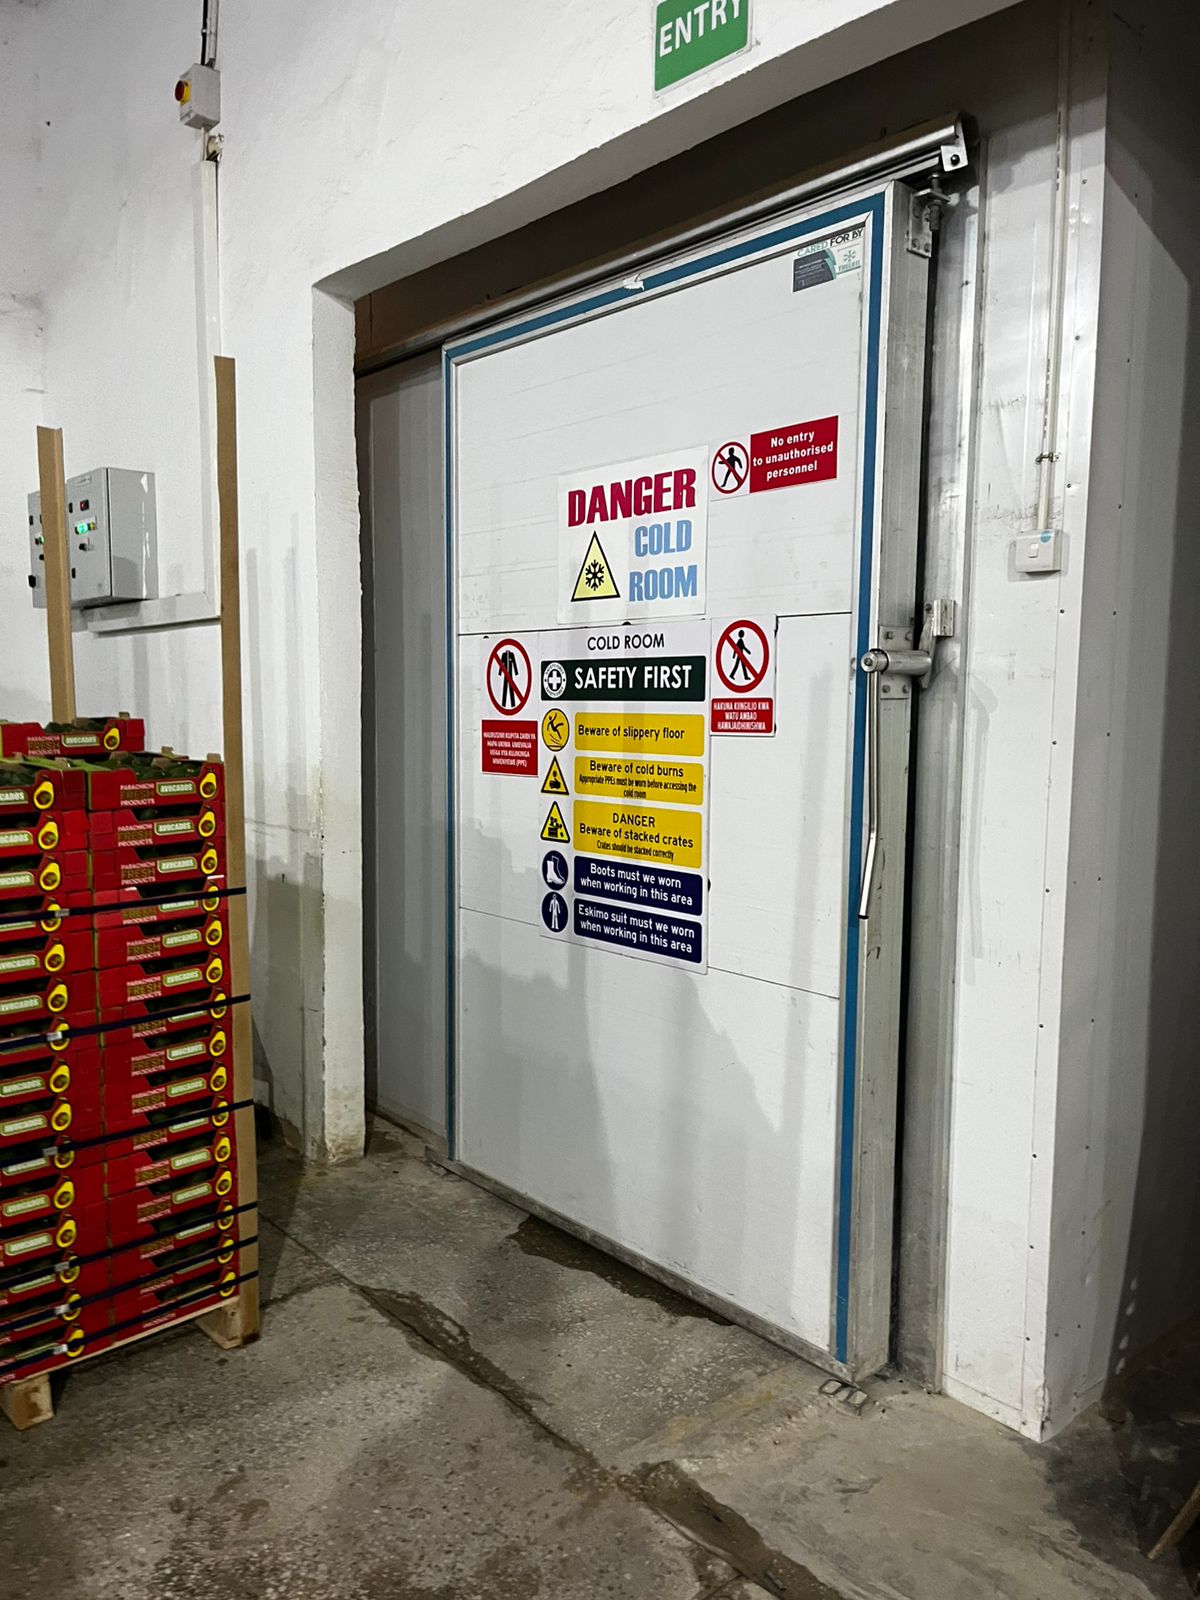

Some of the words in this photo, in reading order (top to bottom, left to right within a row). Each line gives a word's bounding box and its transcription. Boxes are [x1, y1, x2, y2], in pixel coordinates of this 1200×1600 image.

[660, 0, 740, 57] ENTRY
[798, 241, 828, 256] CARED
[830, 234, 850, 246] FOR
[852, 228, 864, 239] BY
[770, 437, 784, 448] No
[786, 431, 814, 442] entry
[752, 457, 762, 466] to
[766, 441, 834, 464] unauthorised
[766, 460, 818, 482] personnel
[568, 468, 696, 527] DANGER
[635, 519, 692, 557] COLD
[629, 564, 698, 602] ROOM
[588, 636, 620, 650] COLD
[624, 633, 664, 649] ROOM
[574, 666, 638, 689] SAFETY
[644, 664, 692, 689] FIRST
[66, 736, 96, 744] AVOCADOS
[578, 724, 610, 736] Beware
[612, 726, 620, 736] of
[623, 726, 660, 741] slippery
[662, 727, 685, 738] floor
[590, 760, 622, 772] Beware
[624, 763, 634, 774] of
[636, 764, 654, 775] cold
[658, 766, 684, 778] burns
[160, 783, 193, 792] AVOCADOS
[579, 774, 604, 784] Appropriate
[604, 776, 616, 785] PPEs
[616, 777, 627, 786] must
[628, 777, 634, 786] be
[634, 779, 646, 788] worn
[647, 779, 663, 789] before
[663, 781, 687, 793] accessing
[688, 783, 696, 792] the
[120, 789, 155, 800] FRESH
[120, 798, 156, 807] PRODUCTS
[623, 789, 633, 798] cold
[634, 791, 646, 799] room
[158, 822, 191, 832] AVOCADOS
[612, 812, 656, 828] DANGER
[118, 830, 153, 841] FRESH
[118, 839, 153, 847] PRODUCTS
[580, 823, 611, 837] Beware
[613, 828, 622, 838] of
[624, 830, 660, 844] stacked
[662, 835, 694, 848] crates
[597, 840, 611, 849] Crates
[612, 842, 627, 852] should
[627, 845, 633, 853] be
[634, 846, 652, 856] stacked
[652, 848, 674, 862] correctly
[161, 859, 194, 870] AVOCADOS
[121, 868, 156, 880] FRESH
[121, 876, 156, 886] PRODUCTS
[590, 863, 616, 878] Boots
[617, 870, 640, 882] must
[642, 873, 656, 884] we
[658, 877, 682, 889] worn
[580, 876, 602, 889] when
[603, 881, 637, 899] working
[640, 885, 648, 897] in
[650, 888, 668, 901] this
[671, 895, 693, 906] area
[578, 904, 609, 920] Eskimo
[611, 913, 627, 924] suit
[629, 917, 653, 929] must
[655, 922, 669, 932] we
[671, 925, 695, 938] worn
[166, 932, 198, 945] AVOCADOS
[580, 920, 602, 932] when
[603, 925, 637, 944] working
[639, 931, 648, 943] in
[650, 934, 668, 948] this
[670, 942, 693, 953] area
[127, 944, 161, 956] FRESH
[126, 982, 161, 996] FRESH
